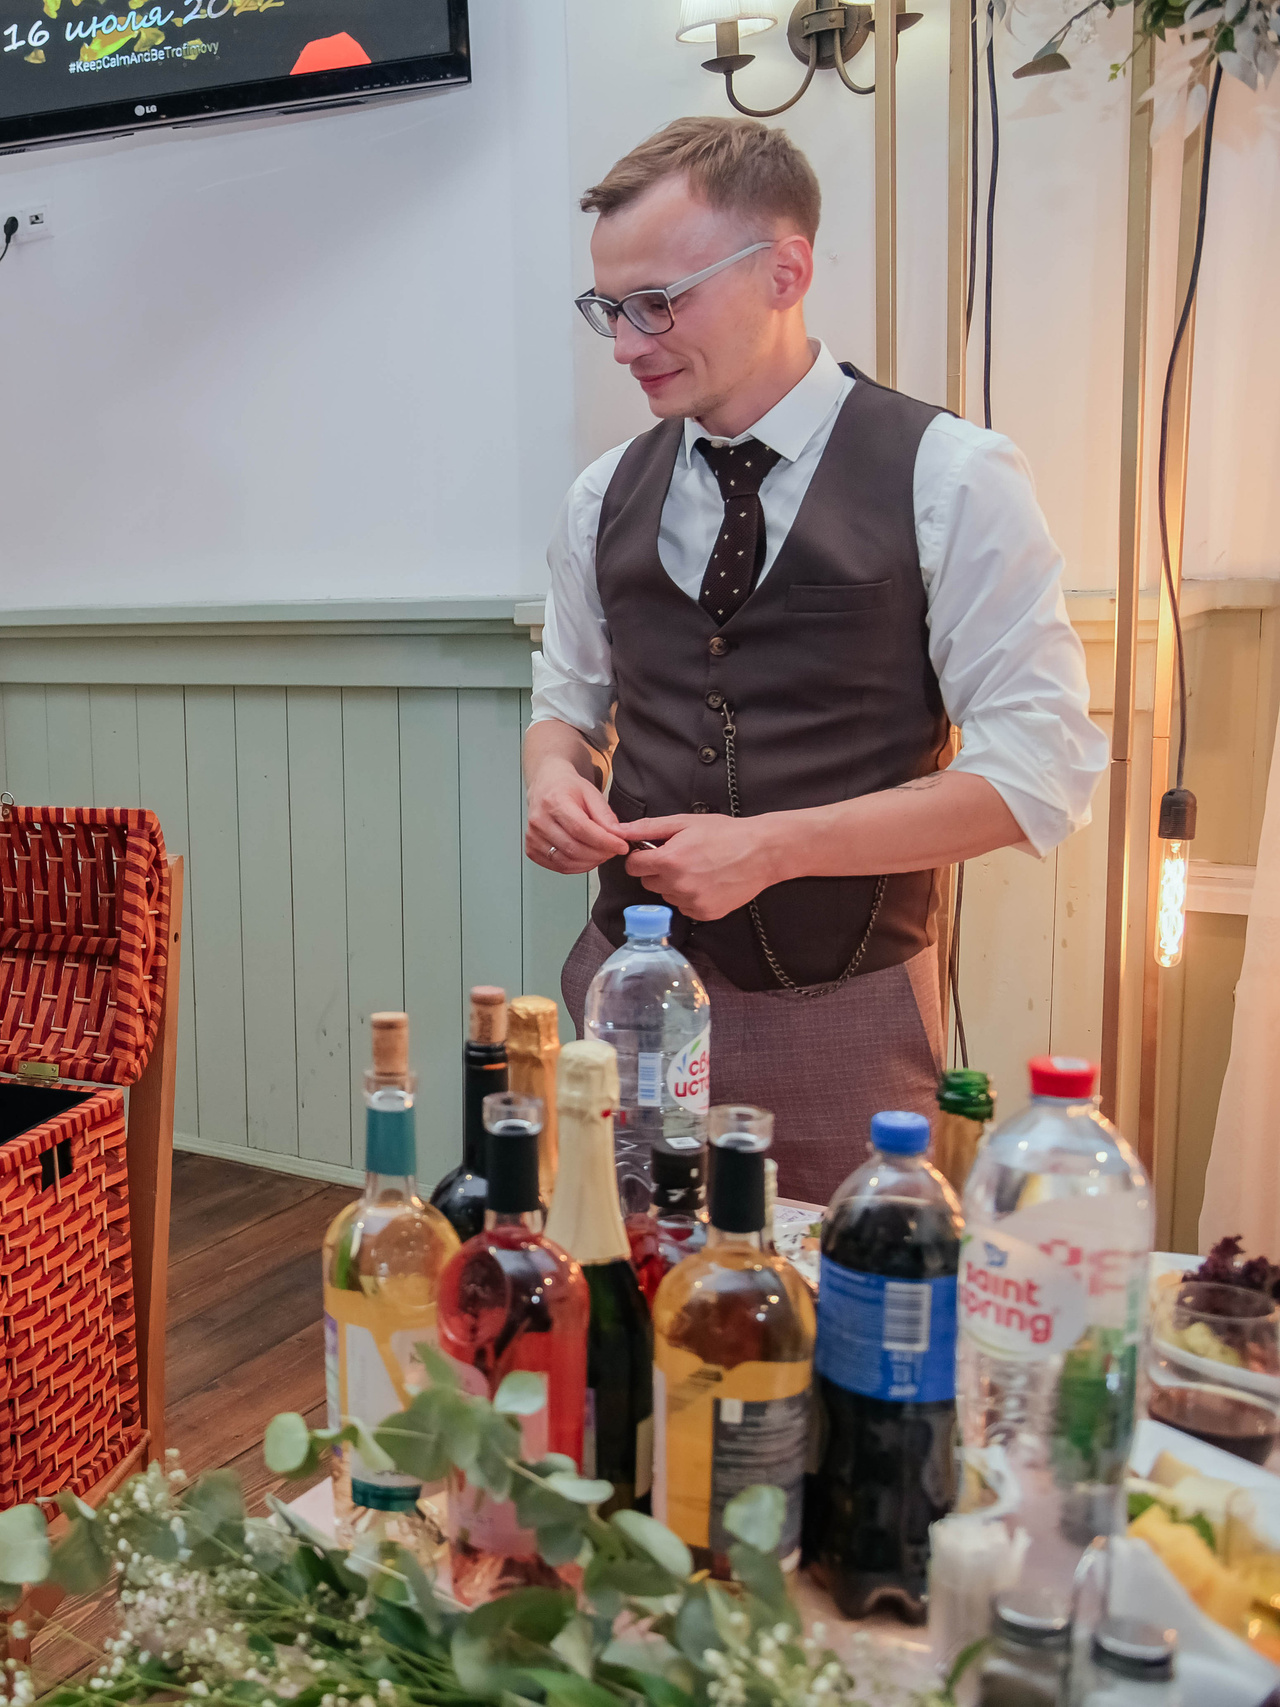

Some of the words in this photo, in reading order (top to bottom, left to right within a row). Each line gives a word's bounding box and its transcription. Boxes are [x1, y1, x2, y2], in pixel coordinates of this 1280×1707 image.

[3, 20, 50, 52] 16
[65, 6, 174, 41] июля
[68, 41, 220, 74] #KeepCalmAndBeTrofimovy
